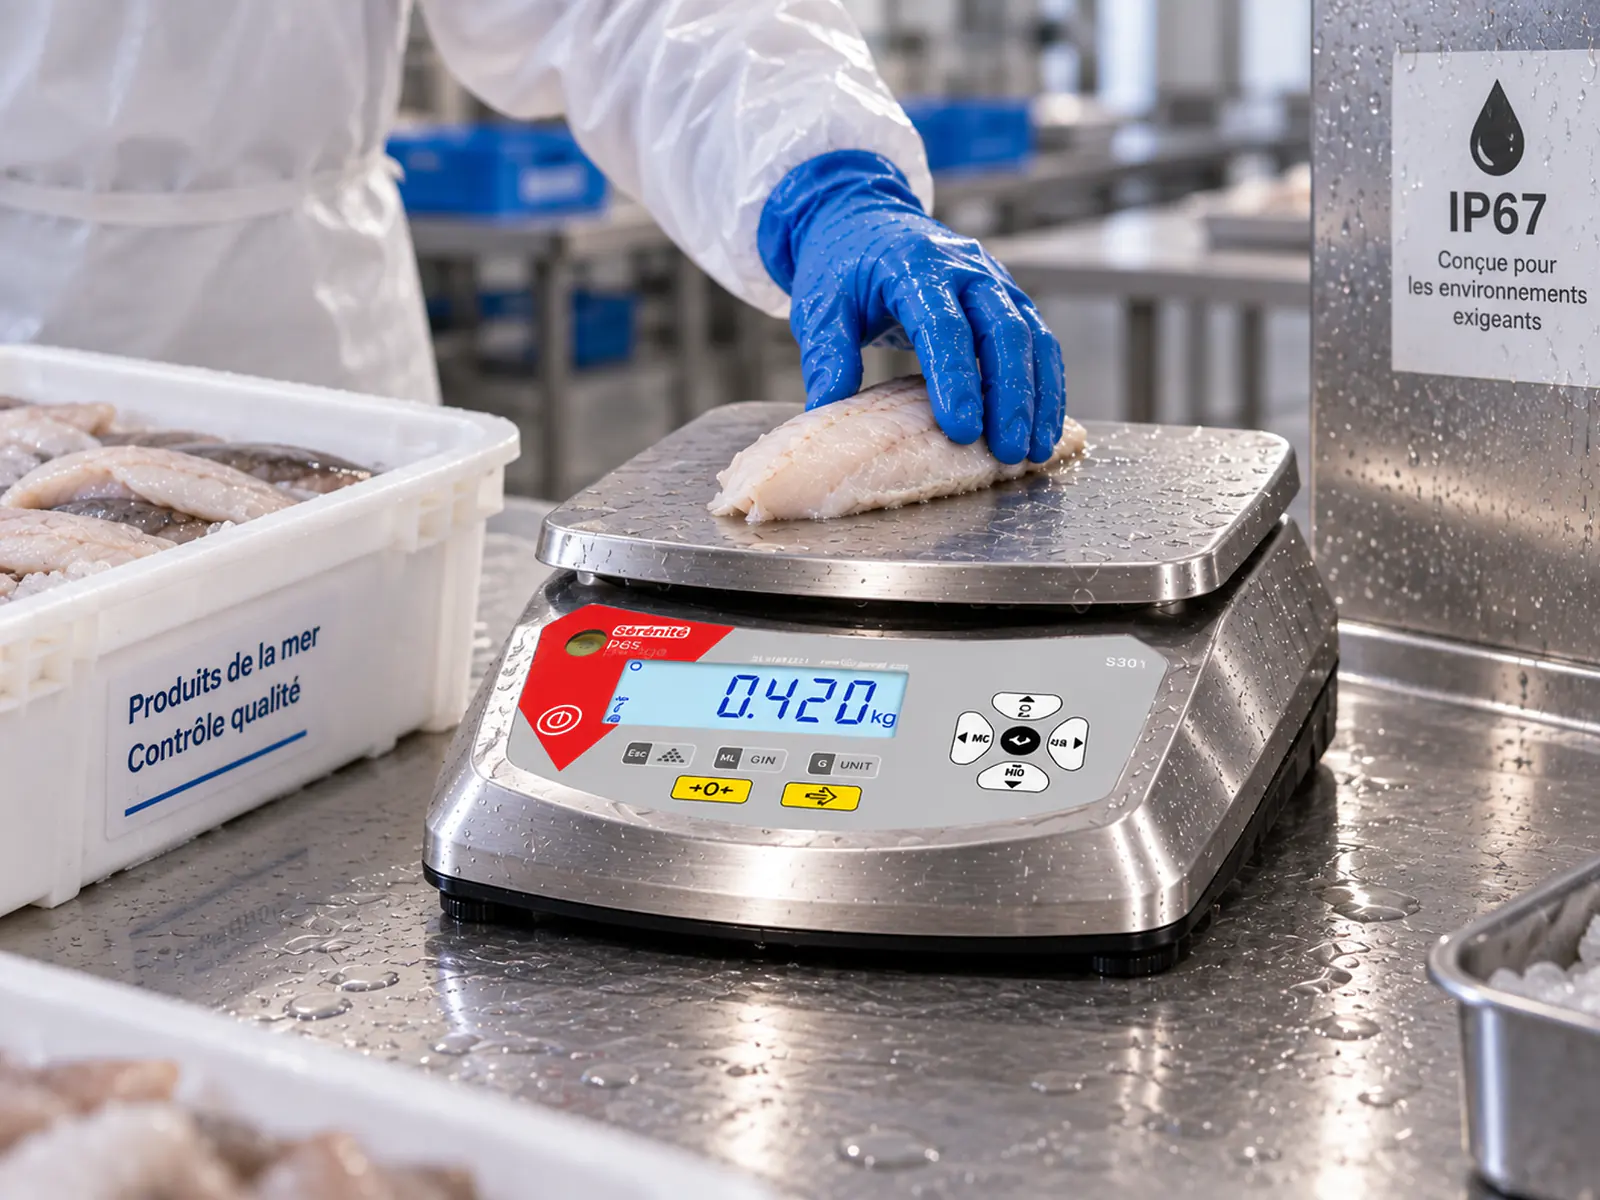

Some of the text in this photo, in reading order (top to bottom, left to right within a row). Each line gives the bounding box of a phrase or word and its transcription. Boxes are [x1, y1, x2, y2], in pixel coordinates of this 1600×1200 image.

[1450, 191, 1547, 235] IP67
[1438, 250, 1557, 277] Conçue pour
[1408, 275, 1588, 304] les environnements
[1453, 307, 1542, 332] exigeants
[128, 625, 320, 725] Produits de la mer
[717, 674, 897, 729] 0.420 kg
[127, 675, 300, 773] Contrôle qualité
[971, 734, 990, 743] MC
[626, 748, 647, 758] Esc
[719, 753, 737, 763] ML
[750, 755, 777, 766] GIN
[840, 761, 873, 771] UNIT
